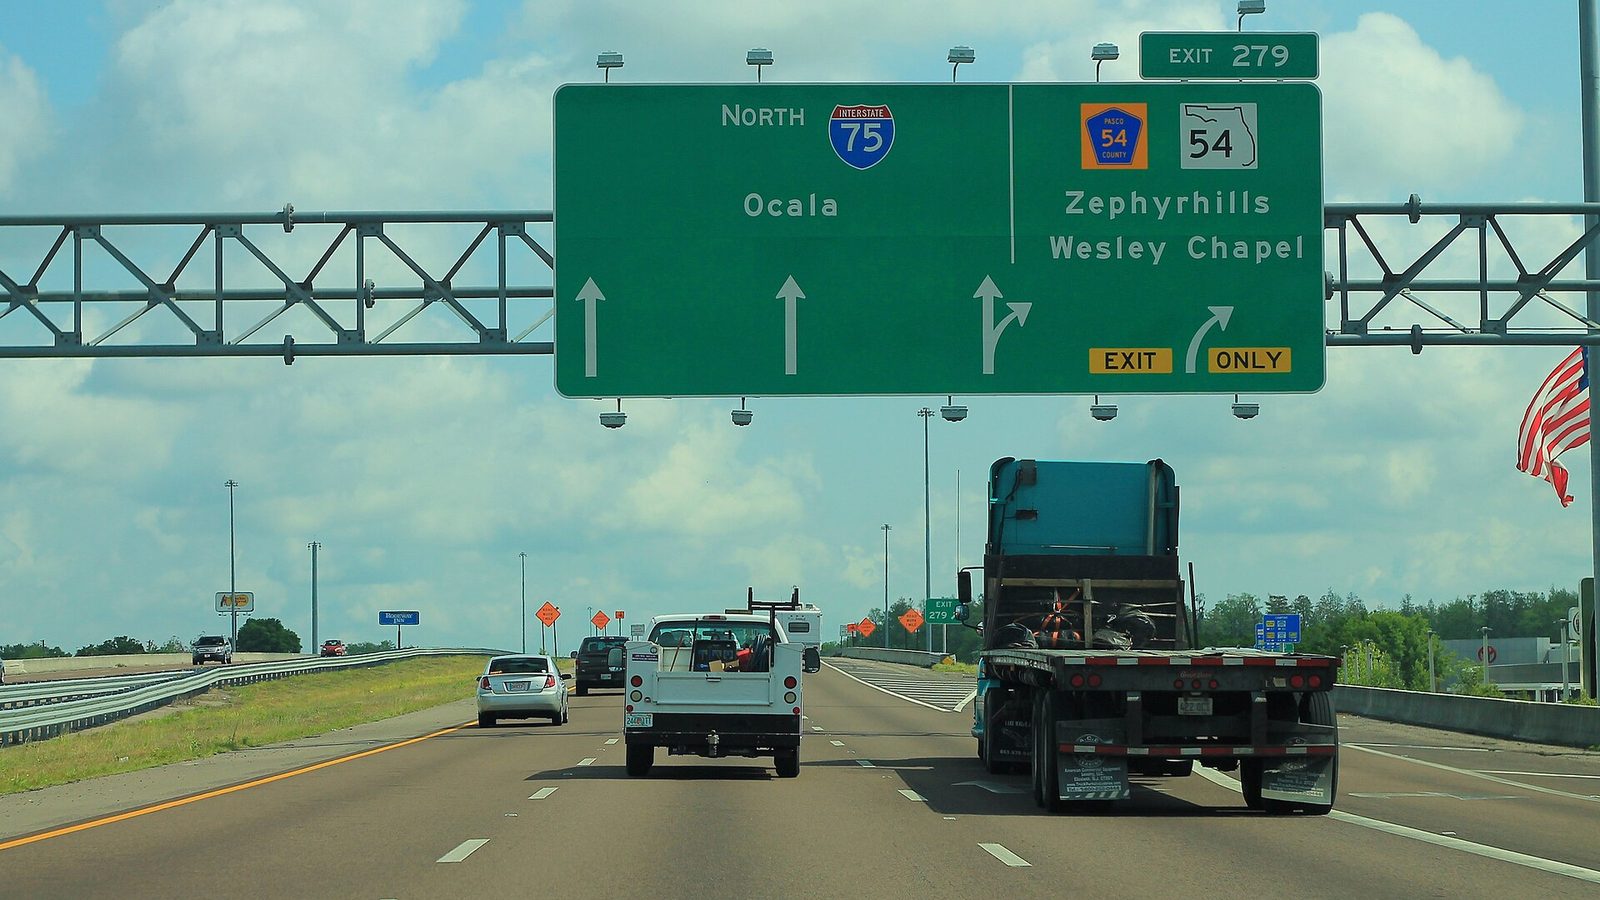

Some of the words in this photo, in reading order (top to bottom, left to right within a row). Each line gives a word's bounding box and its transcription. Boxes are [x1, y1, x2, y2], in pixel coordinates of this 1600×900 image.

[1169, 48, 1213, 63] EXIT
[1232, 45, 1289, 67] 279
[722, 104, 804, 126] NORTH
[839, 109, 884, 118] INTERSTATE
[840, 123, 883, 153] 75
[1101, 129, 1127, 147] 54
[1189, 129, 1233, 159] 54
[1102, 151, 1127, 159] COUNTY
[744, 193, 838, 217] Ocala
[1065, 190, 1271, 220] Zephyrhills
[1050, 236, 1167, 265] Wesley
[1187, 235, 1304, 264] Chapel
[1105, 351, 1157, 370] EXIT
[1216, 351, 1283, 369] ONLY
[929, 611, 948, 619] 279
